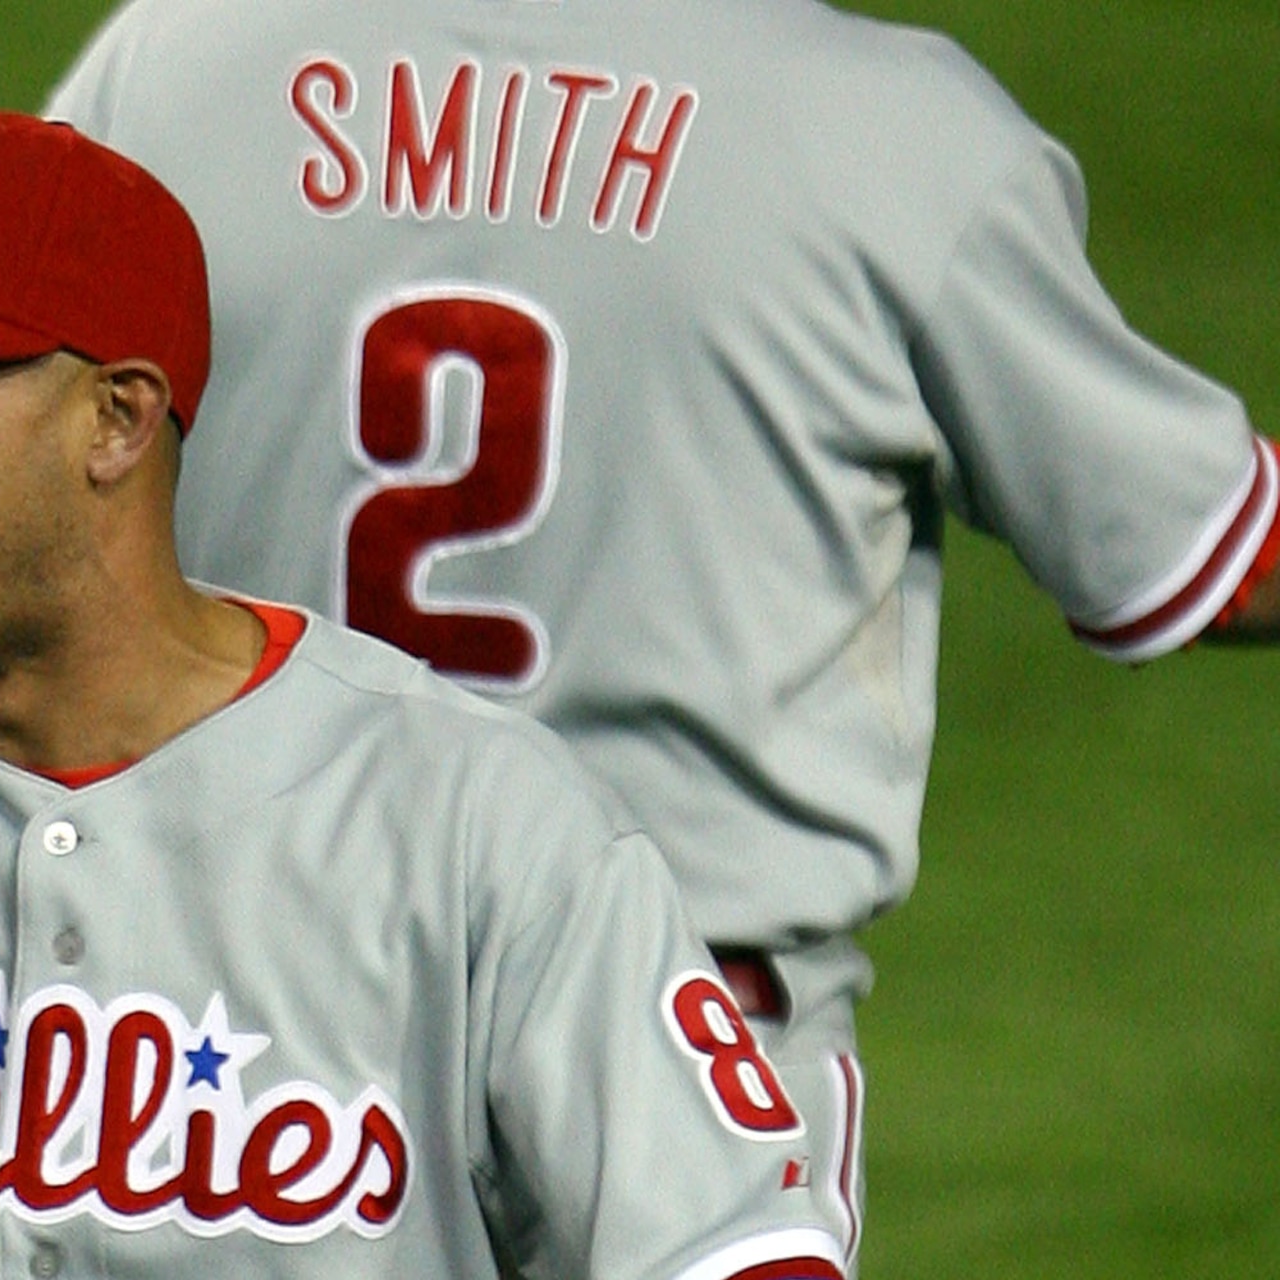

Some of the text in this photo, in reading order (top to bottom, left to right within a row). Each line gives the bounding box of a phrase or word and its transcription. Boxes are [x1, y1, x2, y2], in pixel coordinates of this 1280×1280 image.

[289, 55, 699, 242] SMITH
[338, 279, 568, 692] 2
[660, 968, 808, 1143] 8
